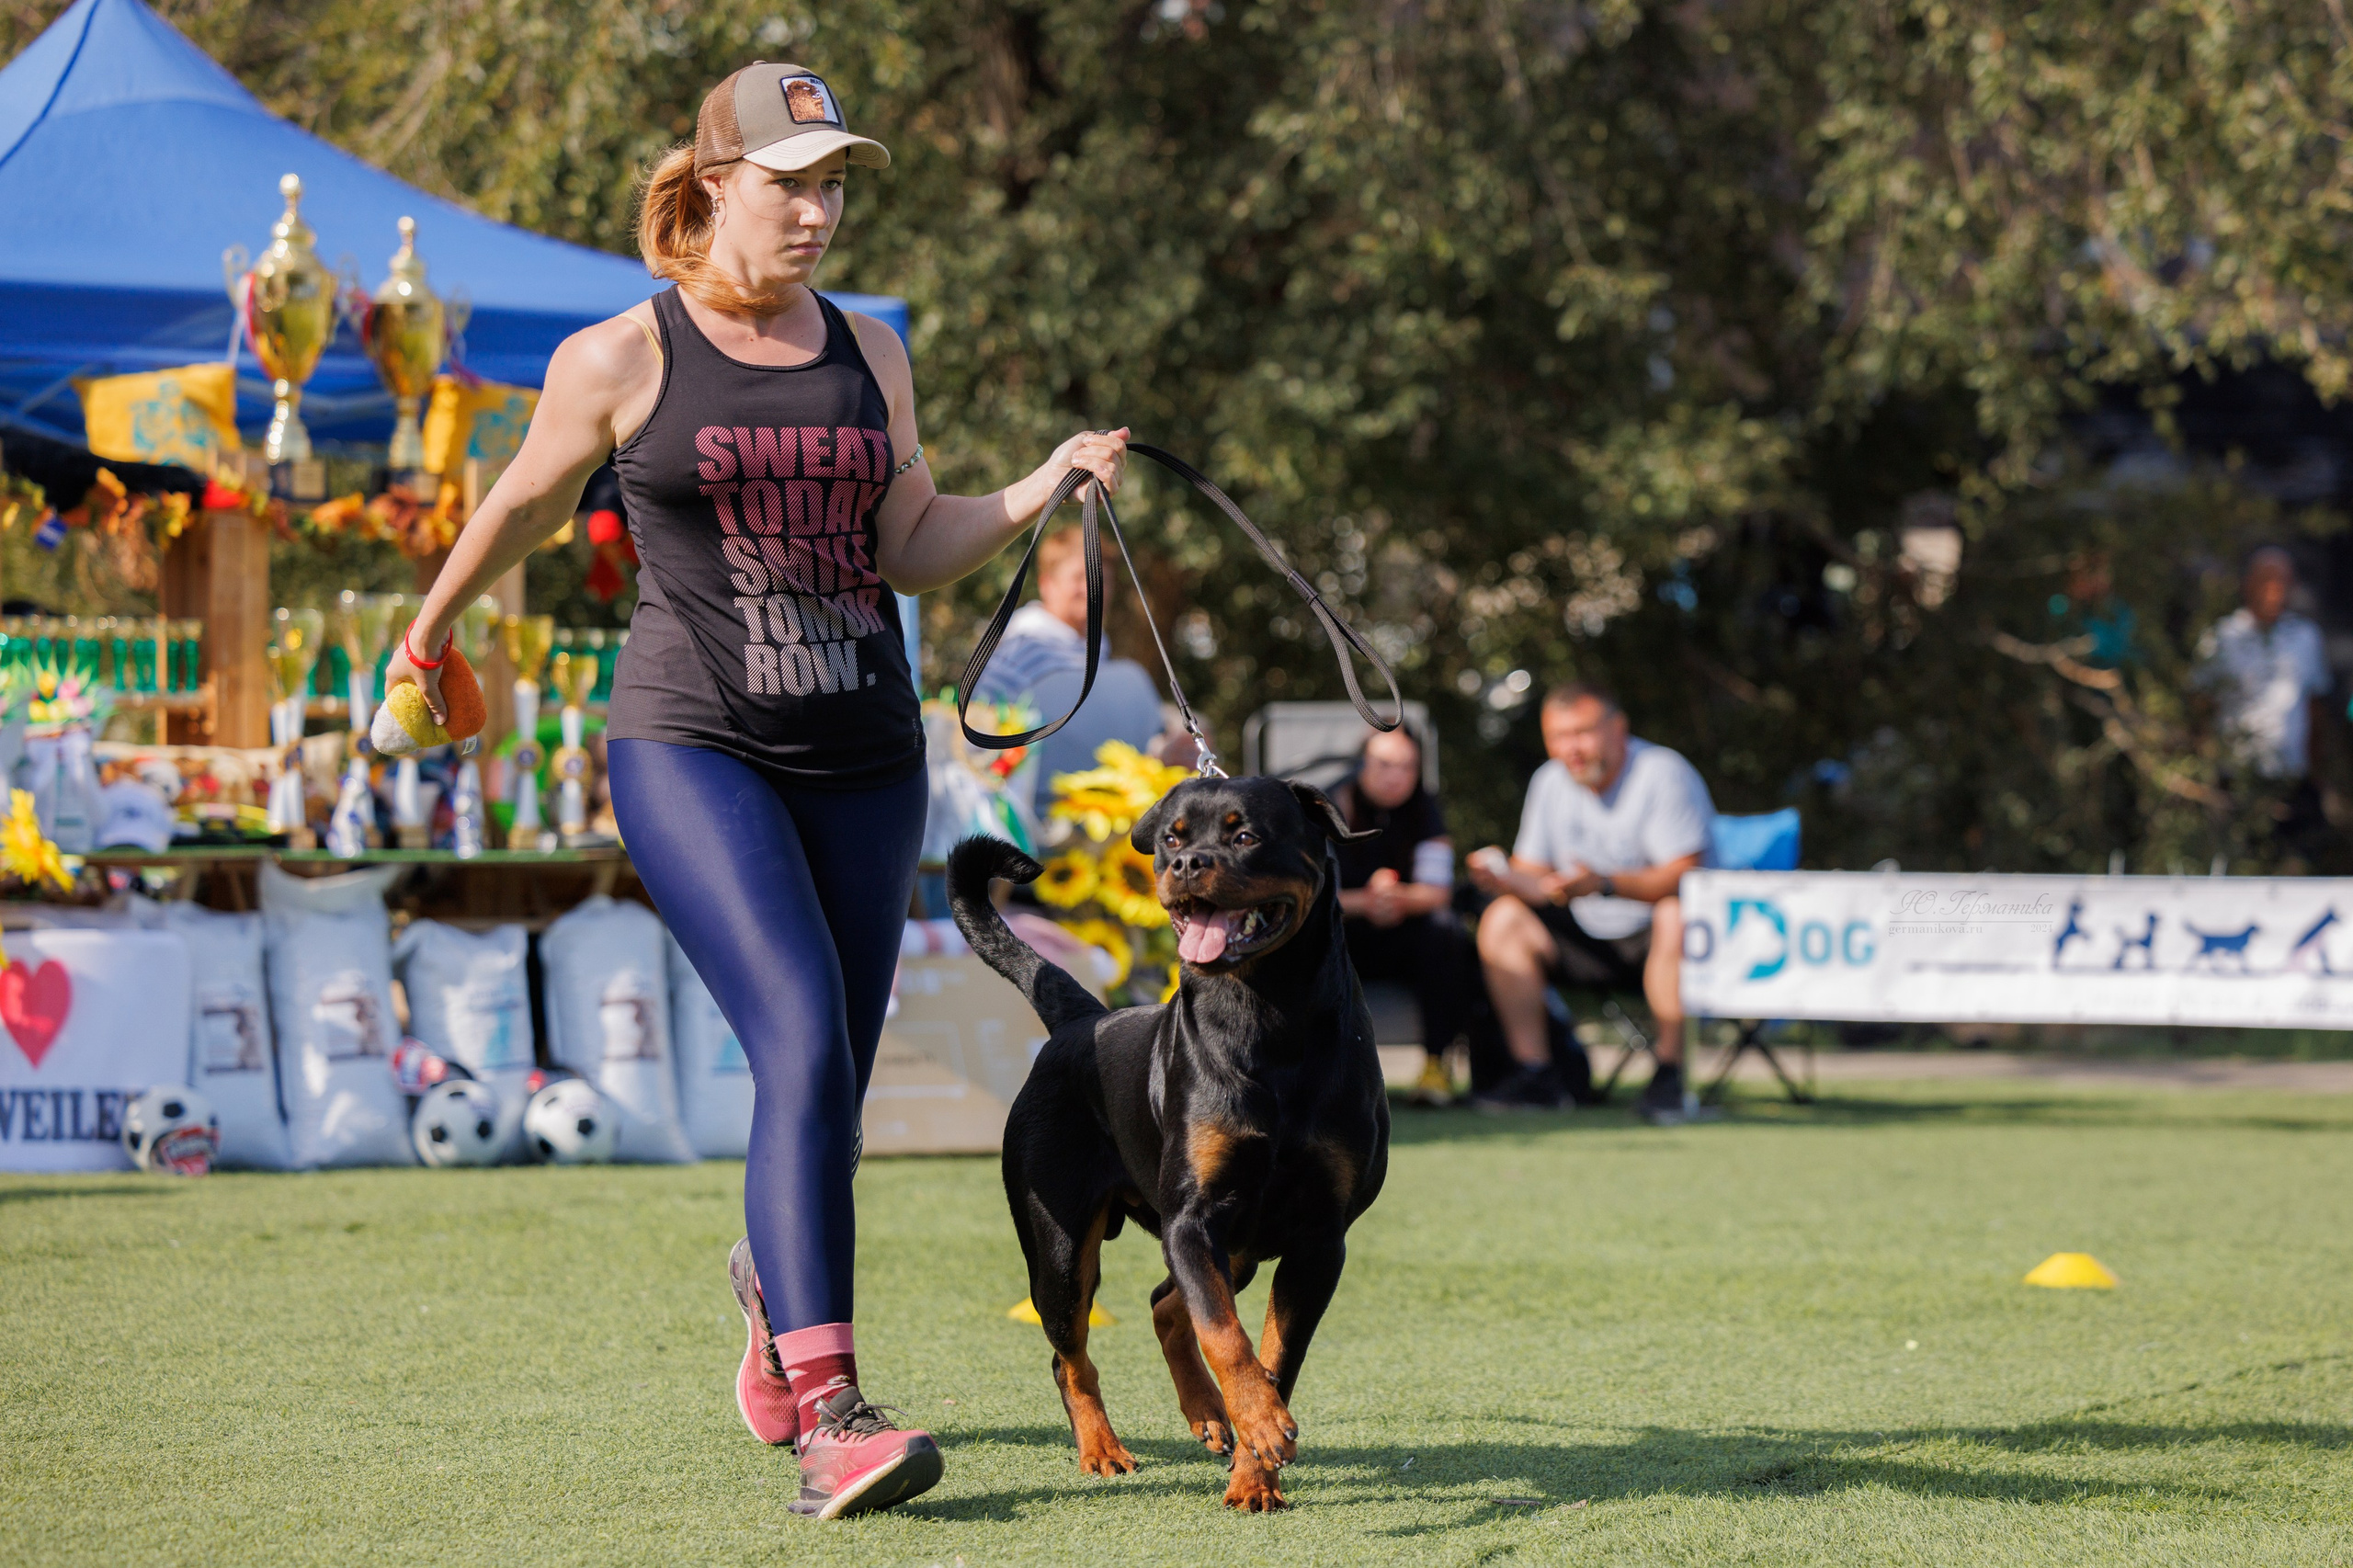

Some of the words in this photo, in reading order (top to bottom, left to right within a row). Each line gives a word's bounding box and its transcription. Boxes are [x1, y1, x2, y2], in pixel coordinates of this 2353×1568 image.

[695, 426, 888, 483] SWEAT
[699, 479, 886, 535] TODAY
[722, 533, 881, 596] SMILE
[733, 587, 885, 644] TOMOR
[744, 640, 877, 697] ROW.
